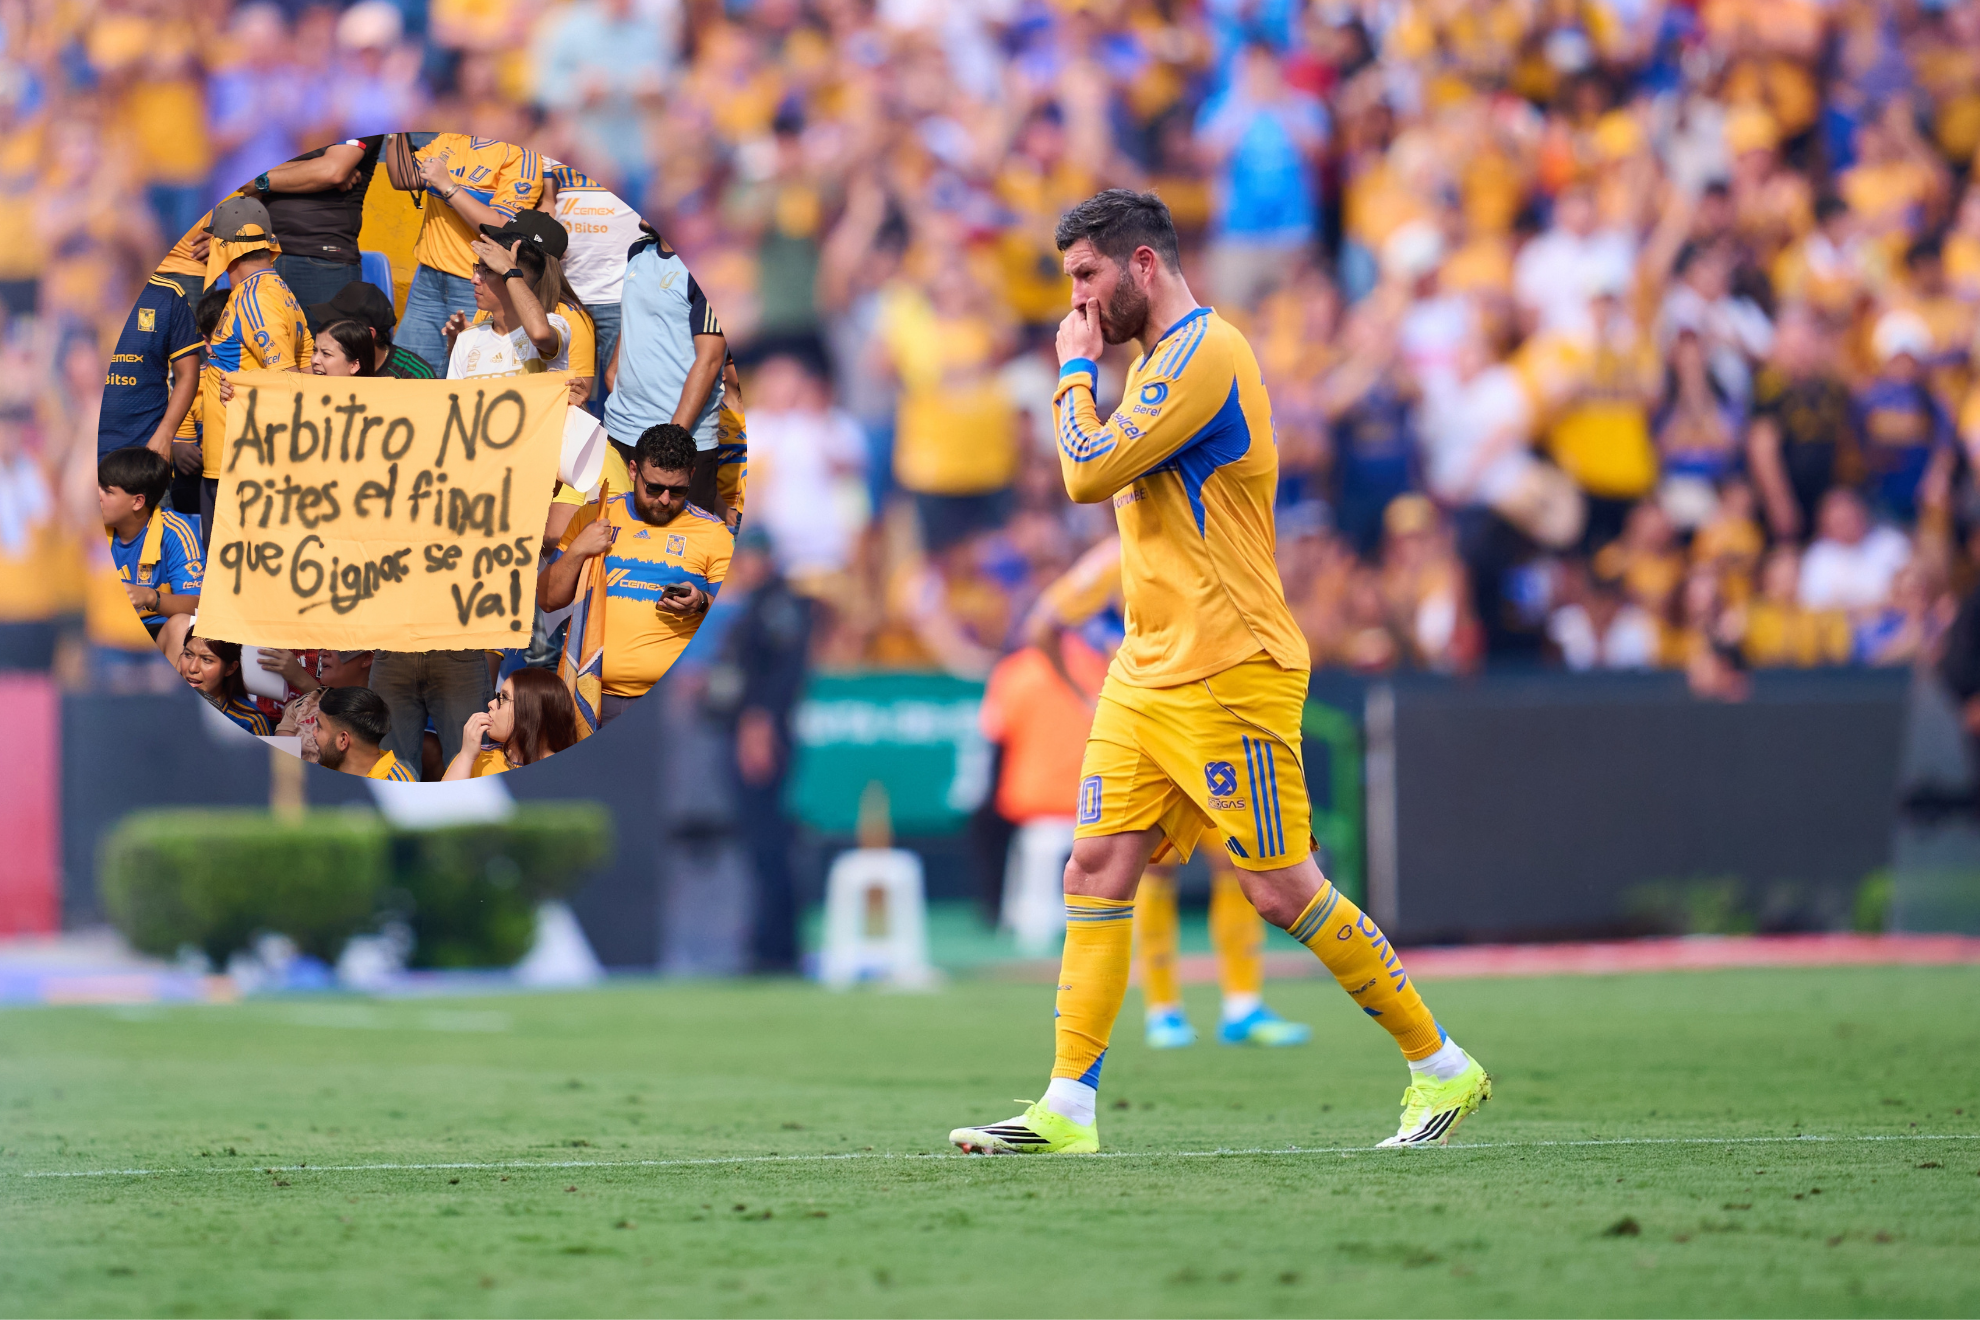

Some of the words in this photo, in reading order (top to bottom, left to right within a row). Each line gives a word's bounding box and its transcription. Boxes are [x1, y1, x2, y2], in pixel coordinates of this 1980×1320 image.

[573, 207, 615, 216] CEMEX
[575, 222, 608, 233] Bitso
[1133, 404, 1162, 417] Berel
[227, 388, 415, 473] Arbitro
[435, 389, 526, 468] NO
[354, 462, 398, 518] el
[408, 466, 512, 537] final
[220, 540, 284, 595] que
[424, 543, 463, 573] se
[473, 536, 533, 579] nos
[619, 579, 665, 592] CEMEX
